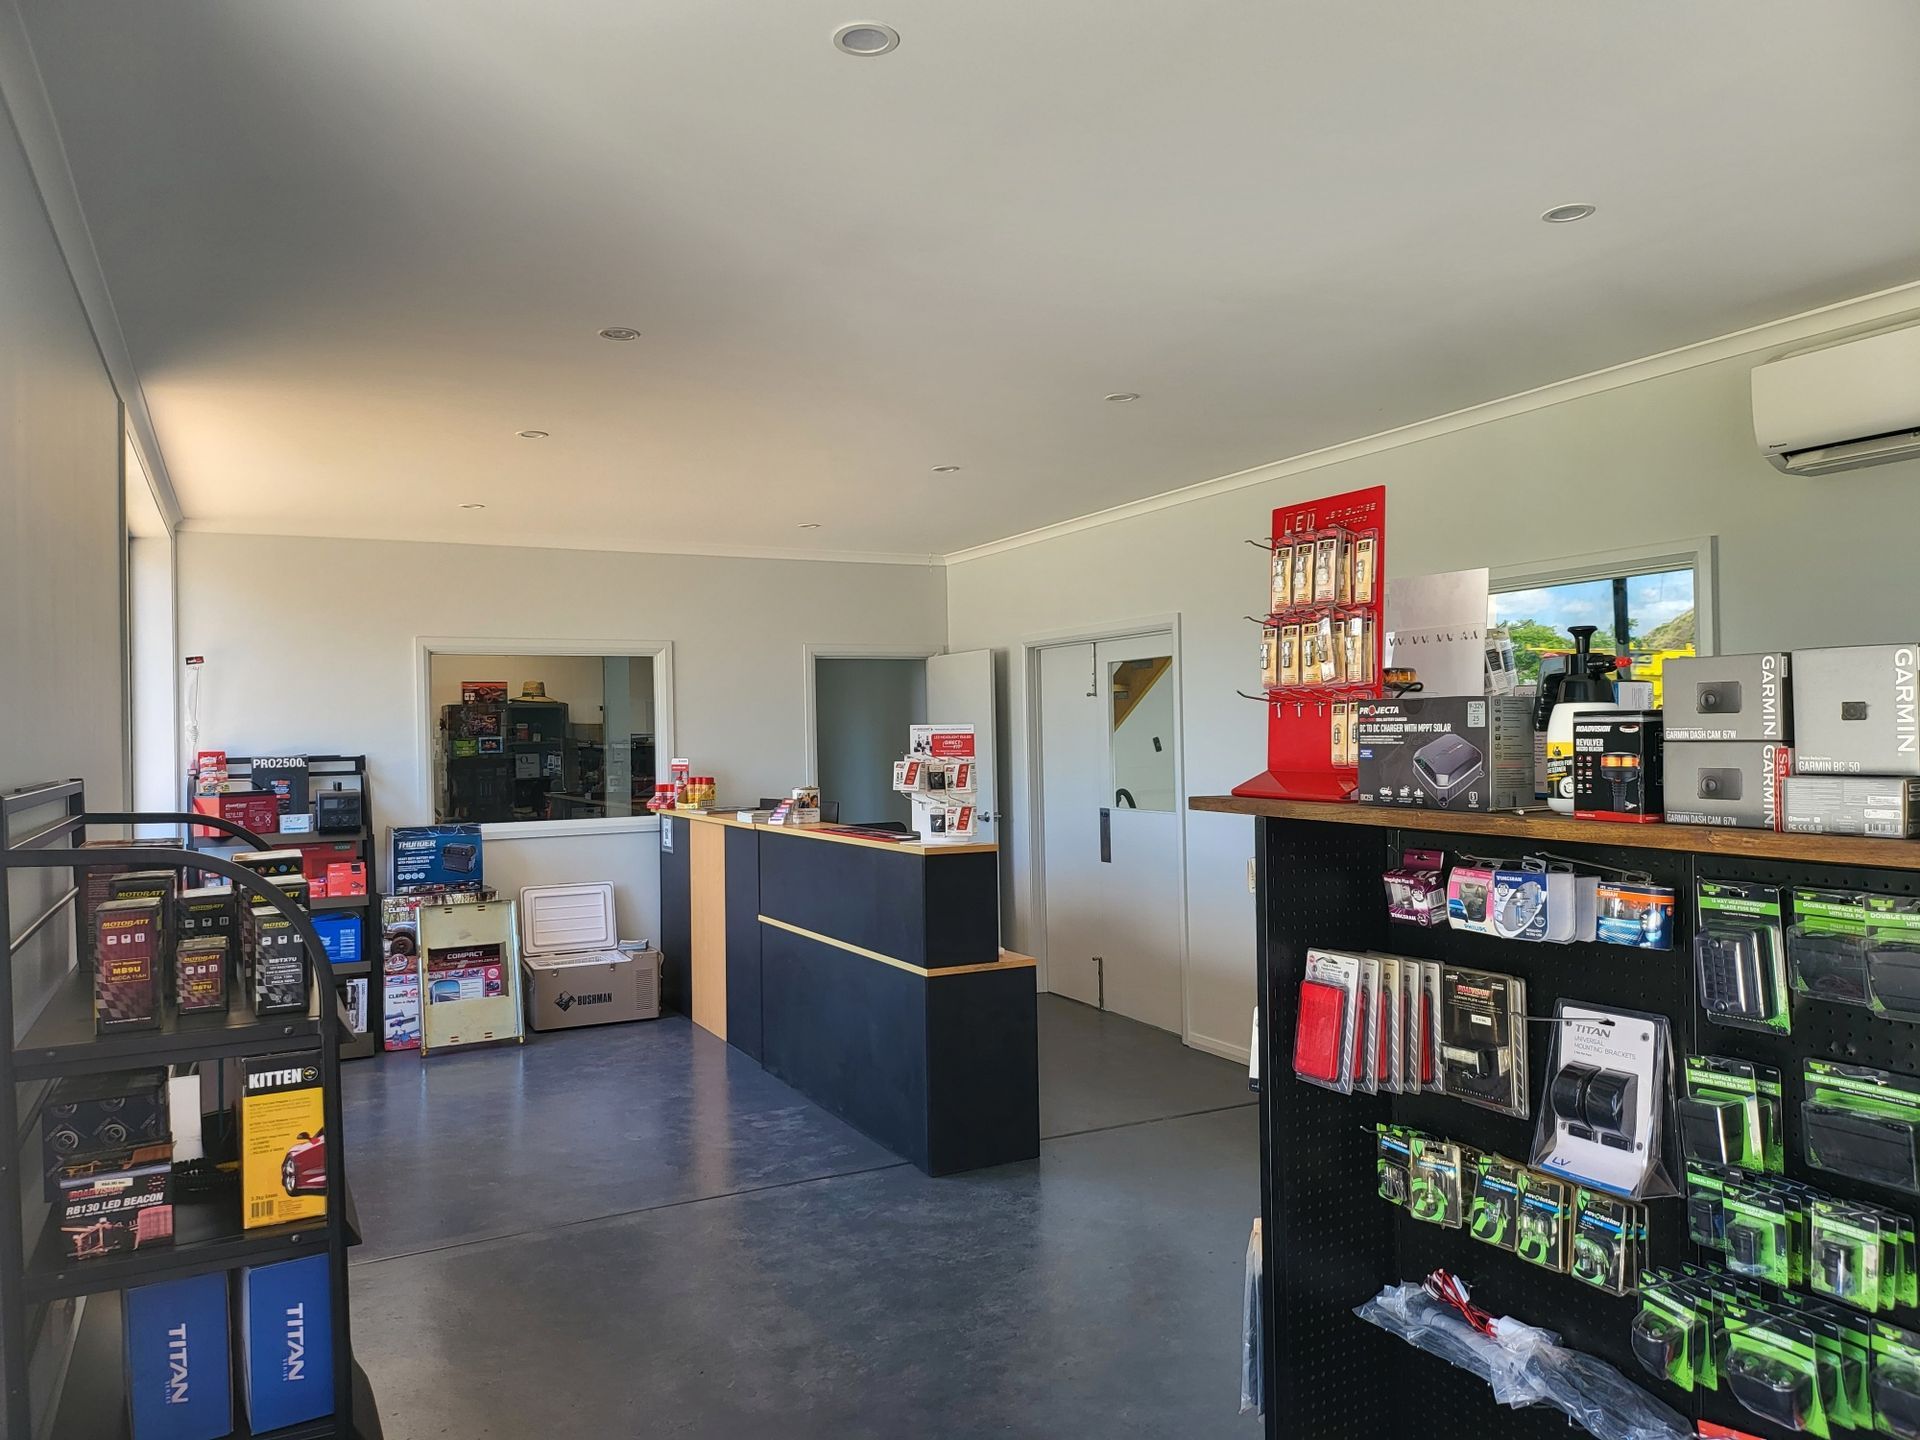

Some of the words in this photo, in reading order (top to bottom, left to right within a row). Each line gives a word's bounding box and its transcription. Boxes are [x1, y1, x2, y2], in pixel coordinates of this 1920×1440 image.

[1762, 656, 1776, 735] GARMIN
[1894, 648, 1916, 752] GARMIN
[1360, 706, 1399, 716] PROJECTA
[1360, 724, 1366, 732] DC
[1367, 724, 1372, 732] TO
[1373, 724, 1380, 732] DC
[1381, 724, 1403, 732] CHARGER
[1404, 724, 1417, 732] WITH
[1418, 724, 1433, 732] MPPT
[1433, 723, 1451, 732] SOLAR
[1666, 731, 1689, 739] GARMIN
[1690, 731, 1706, 739] DASH
[1707, 731, 1720, 739] CAM
[1799, 761, 1831, 771] GARMIN
[1833, 762, 1845, 771] BC
[1848, 762, 1860, 772] 50
[1763, 745, 1775, 825] GARMIN
[1667, 814, 1689, 823] GARMIN
[1690, 815, 1706, 824] DASH
[1707, 816, 1720, 825] CAM
[398, 840, 436, 850] THUNDER
[118, 889, 166, 899] MOTOBATT
[1828, 904, 1852, 912] SURFACE
[102, 918, 150, 930] MOTOBATT
[1464, 924, 1487, 932] PHILIPS
[183, 954, 220, 963] MOTOBATT
[447, 951, 484, 960] COMPACT
[112, 966, 141, 975] MB9U
[1457, 985, 1492, 997] ROADVISION
[578, 992, 613, 1006] BUSHMAN
[1576, 1024, 1611, 1038] TITAN
[1575, 1036, 1604, 1046] UNIVERSAL
[1575, 1043, 1602, 1053] MOUNTING
[1605, 1049, 1636, 1060] BRACKETS
[249, 1068, 302, 1089] KITTEN
[1830, 1078, 1856, 1088] SURFACE
[66, 1203, 99, 1216] RB130
[102, 1200, 121, 1210] LED
[124, 1192, 164, 1206] BEACON
[1525, 1193, 1557, 1206] revolution
[1585, 1210, 1621, 1227] revolution
[287, 1303, 304, 1380] TITAN
[168, 1323, 189, 1403] TITAN
